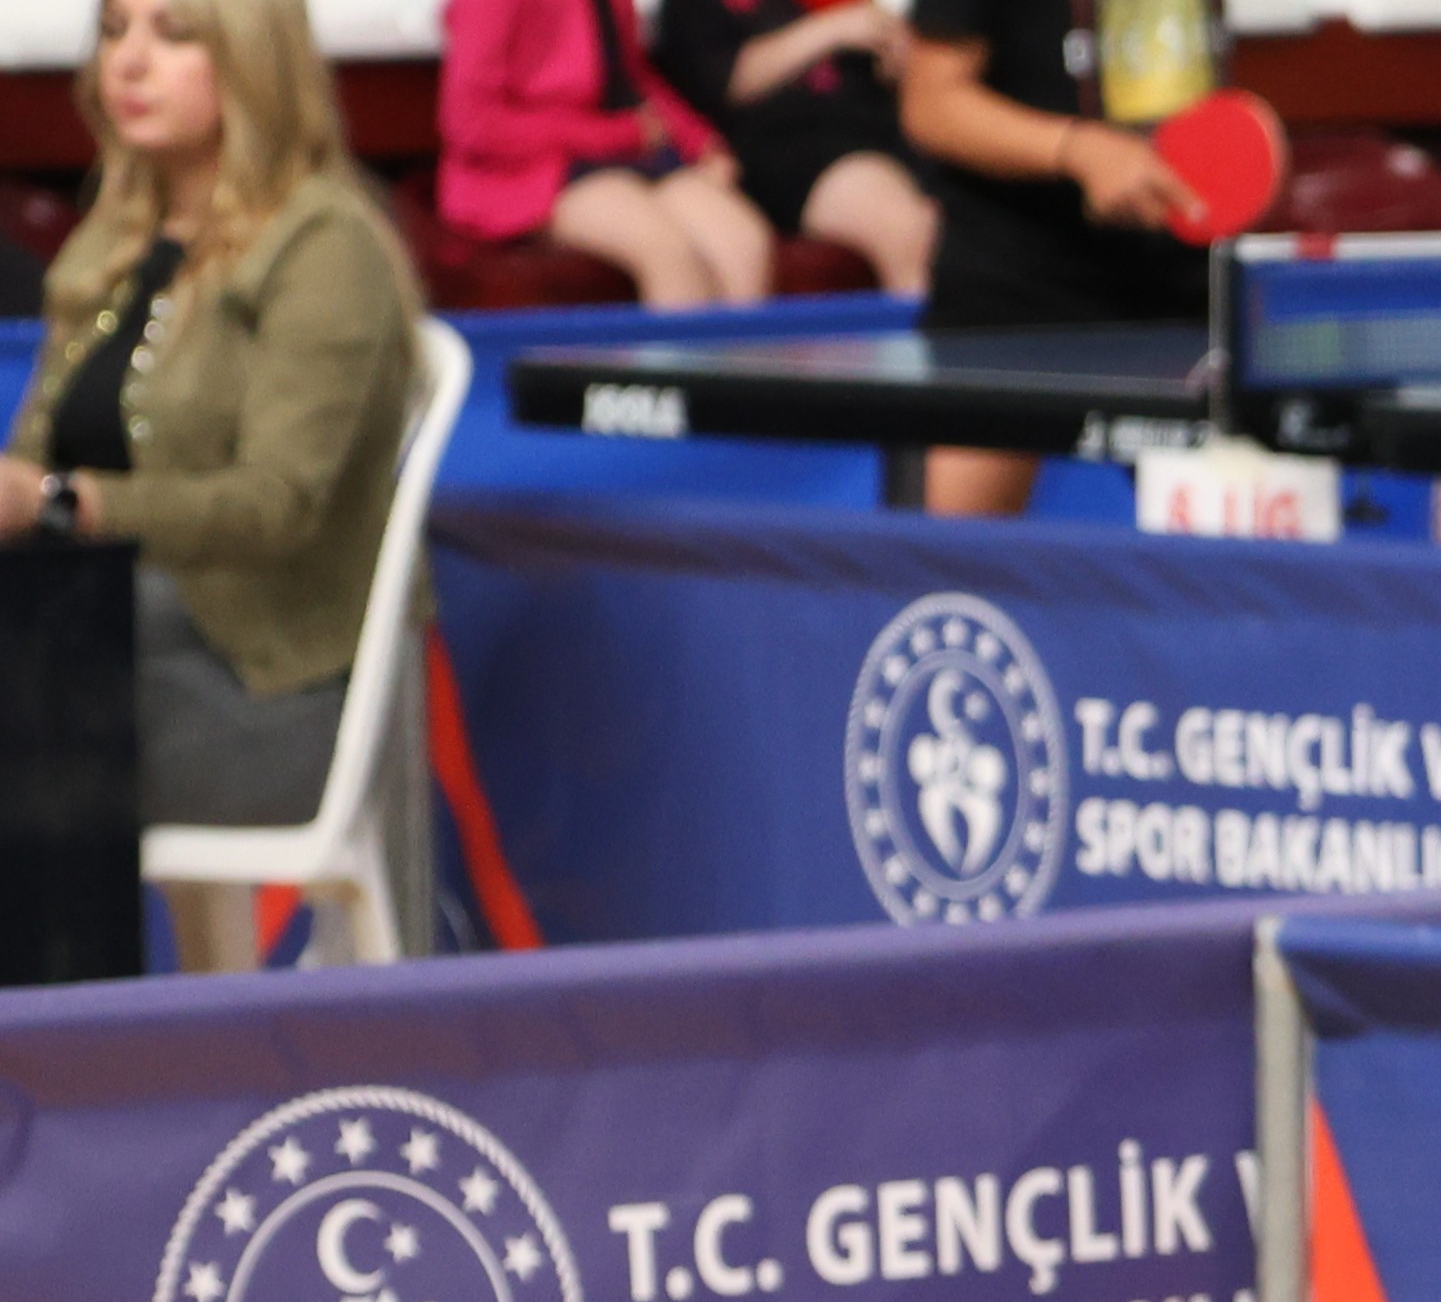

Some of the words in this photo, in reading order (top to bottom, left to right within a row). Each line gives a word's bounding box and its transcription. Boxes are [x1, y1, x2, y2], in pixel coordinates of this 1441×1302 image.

[1075, 698, 1173, 781] T.C.
[1175, 703, 1415, 811] GENÇLİK
[1075, 797, 1211, 884] SPOR
[607, 1193, 783, 1302] T.C.
[806, 1137, 1212, 1295] GENÇLİK
